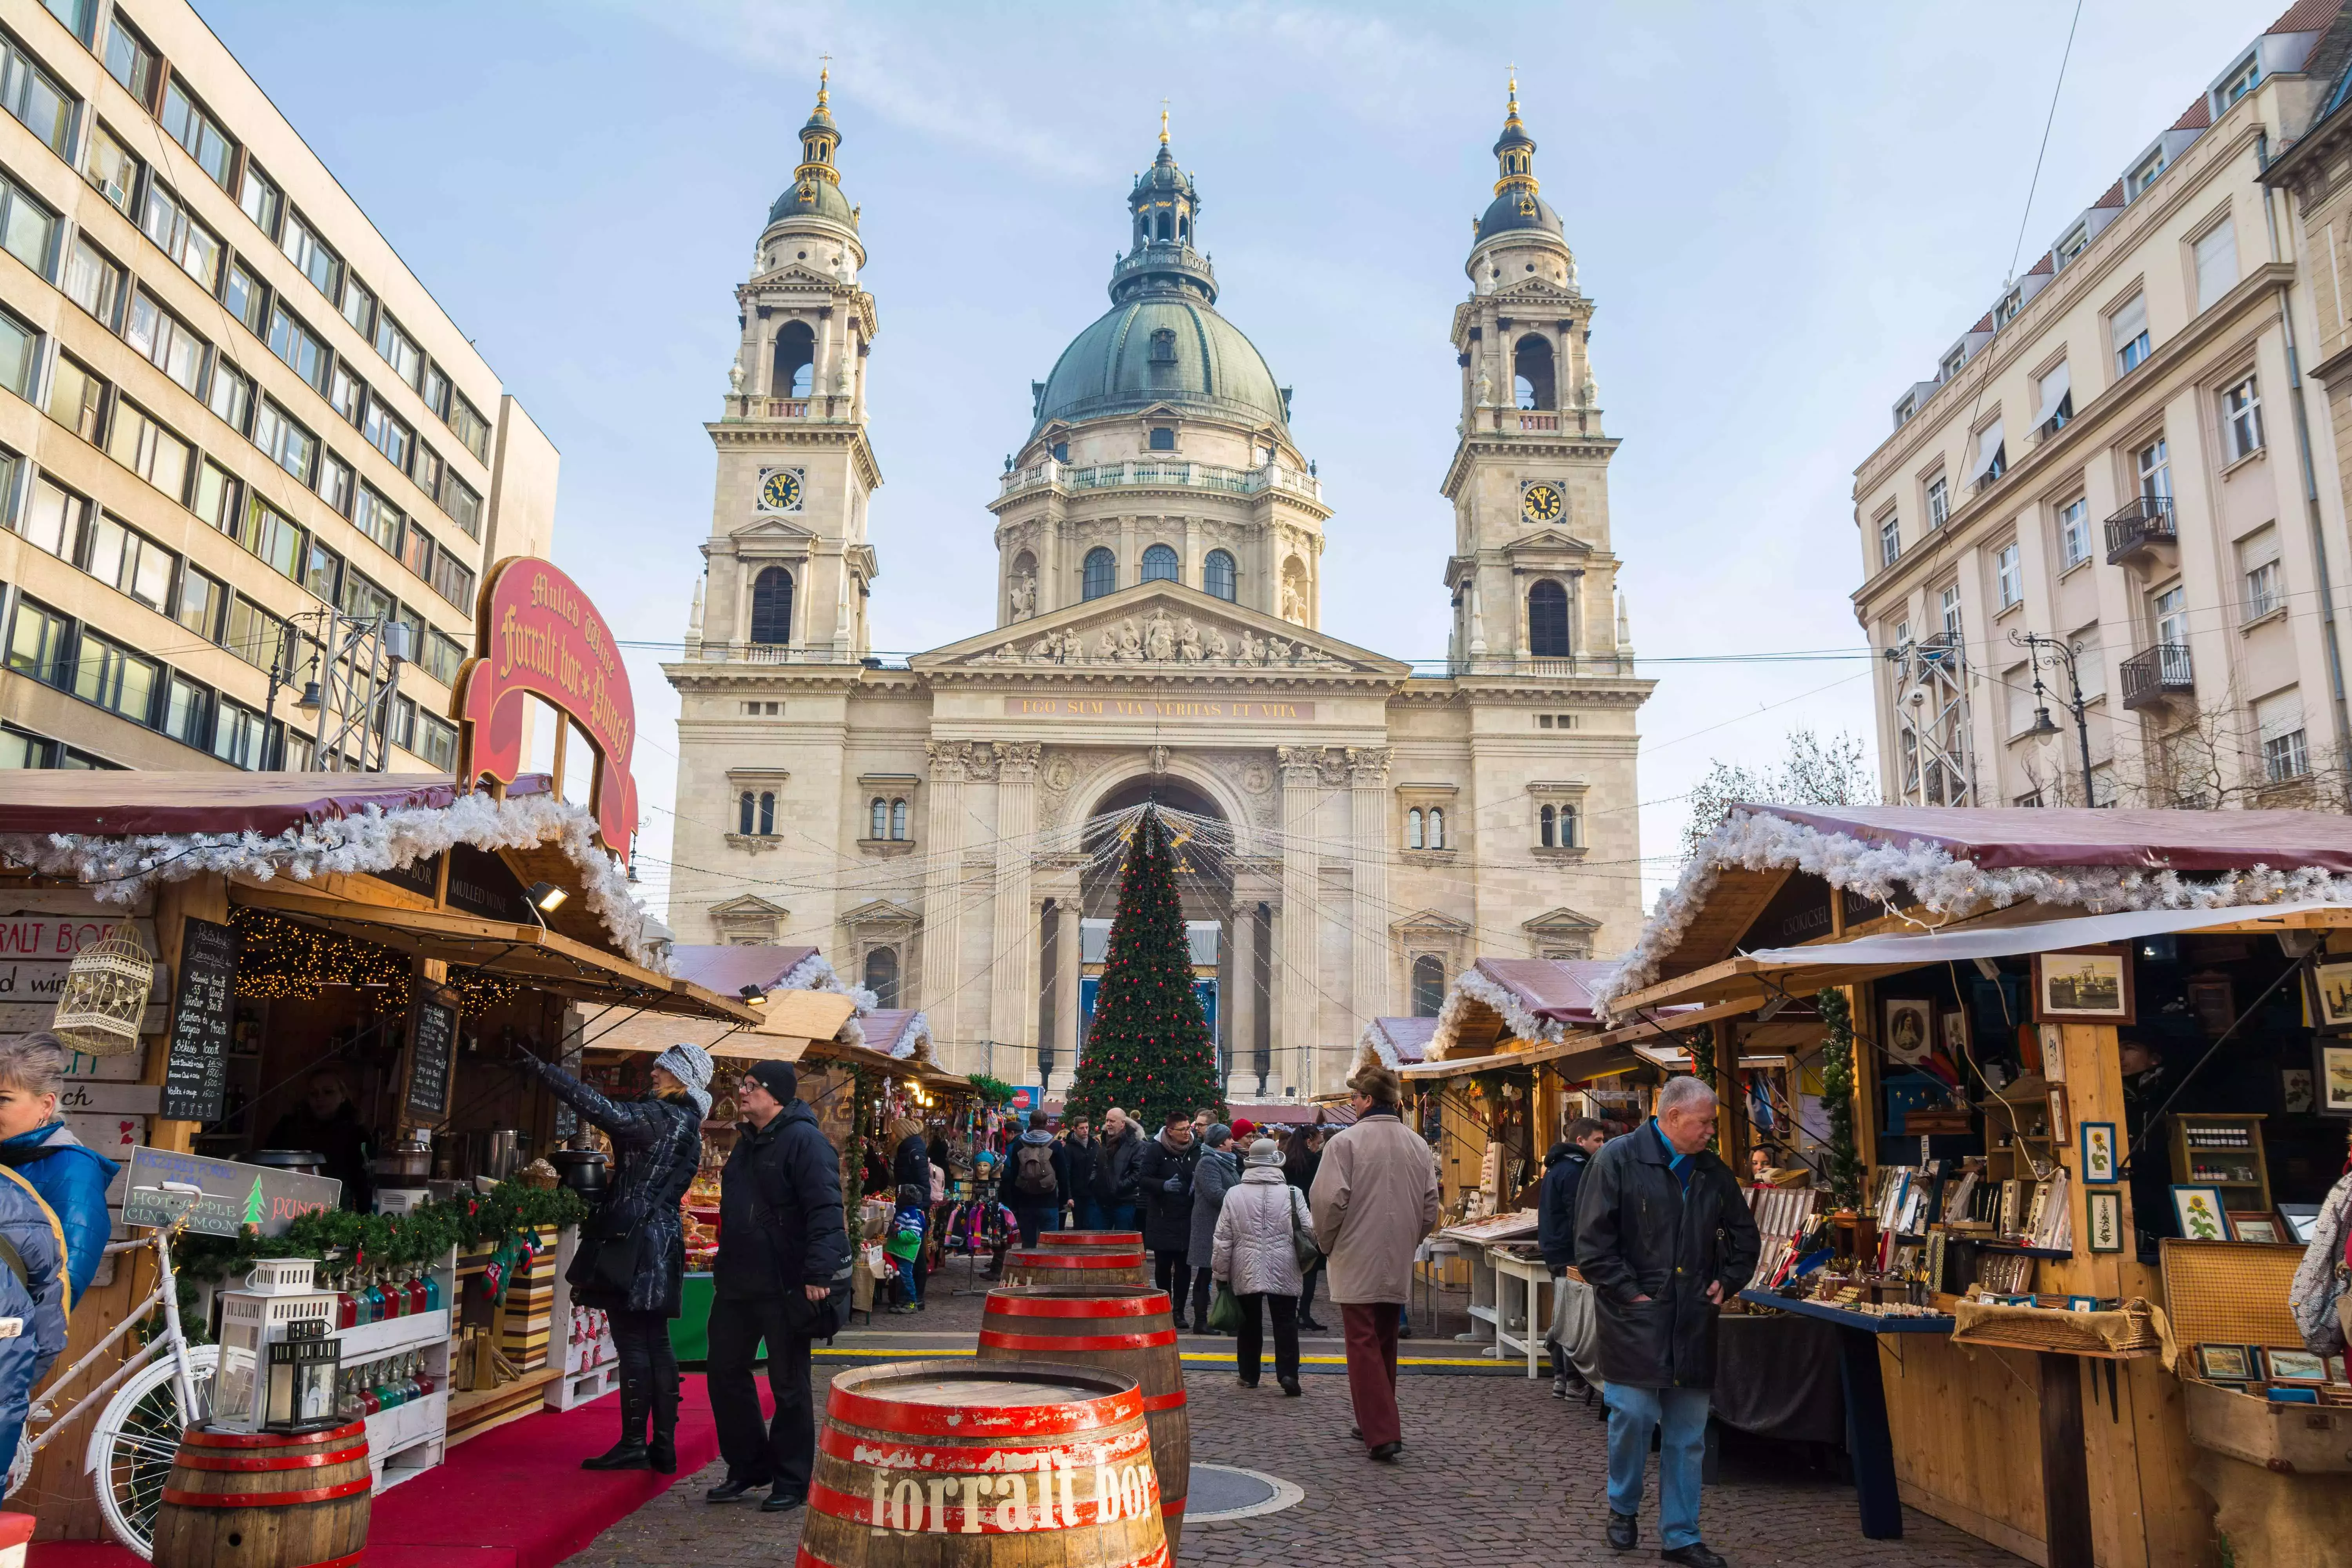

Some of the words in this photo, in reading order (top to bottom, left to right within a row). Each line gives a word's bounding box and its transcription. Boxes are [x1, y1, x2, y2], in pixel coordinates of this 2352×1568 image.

[531, 572, 579, 628] Mulled
[584, 611, 615, 679] Wine
[560, 633, 582, 698] bor
[590, 666, 630, 764] Punch
[1022, 701, 1056, 713] EGO
[1067, 702, 1103, 714] SUM
[1117, 702, 1144, 715] VIA
[1154, 703, 1221, 717] VERITAS
[1232, 704, 1251, 717] ET
[1261, 704, 1296, 718] VITA
[412, 862, 431, 885] BOR
[451, 878, 485, 904] MULLED
[486, 891, 506, 913] WINE
[131, 1192, 174, 1208] HOT
